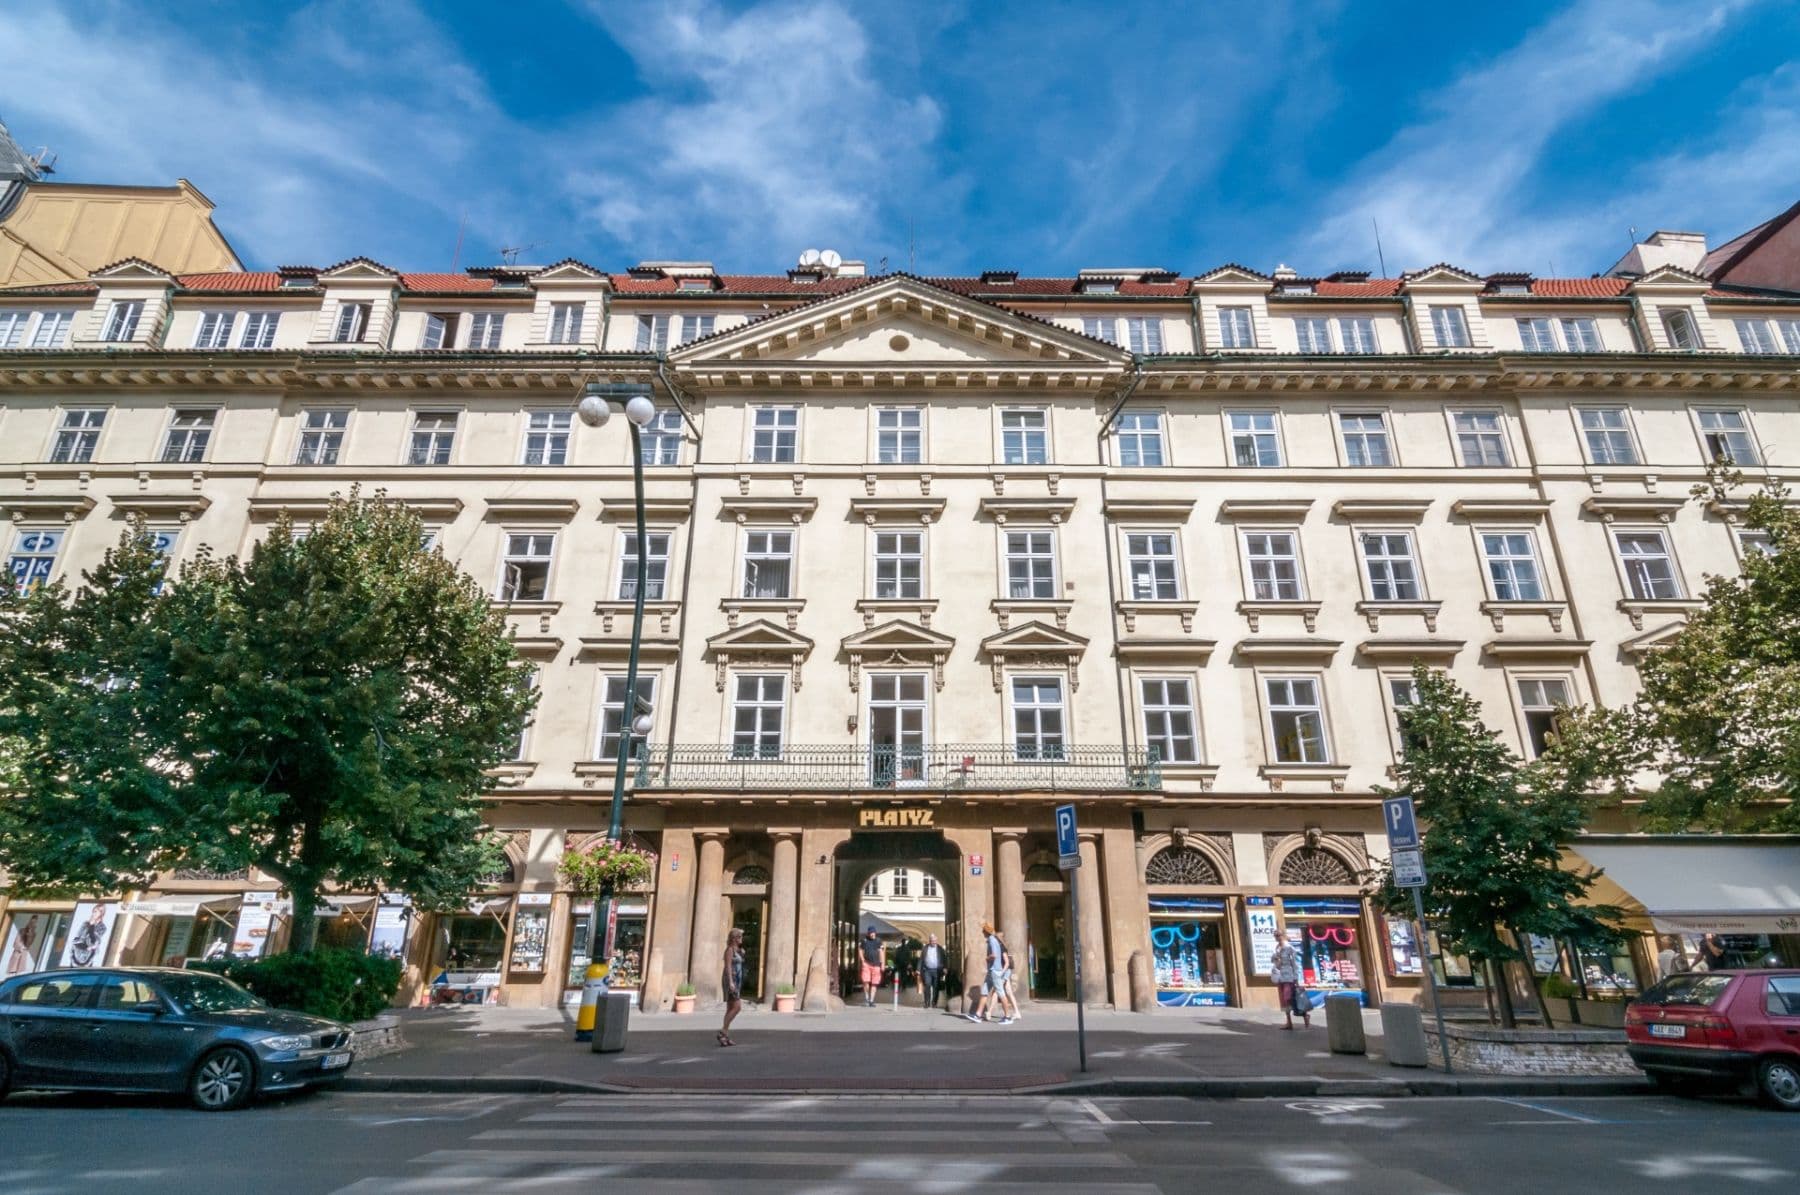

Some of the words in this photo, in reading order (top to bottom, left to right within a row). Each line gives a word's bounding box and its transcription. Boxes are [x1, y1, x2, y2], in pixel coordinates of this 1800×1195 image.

[859, 807, 935, 826] PLATYZ
[1390, 803, 1403, 830] P
[1060, 813, 1071, 841] P
[1251, 914, 1275, 927] 1+1
[1253, 927, 1275, 935] AKCE
